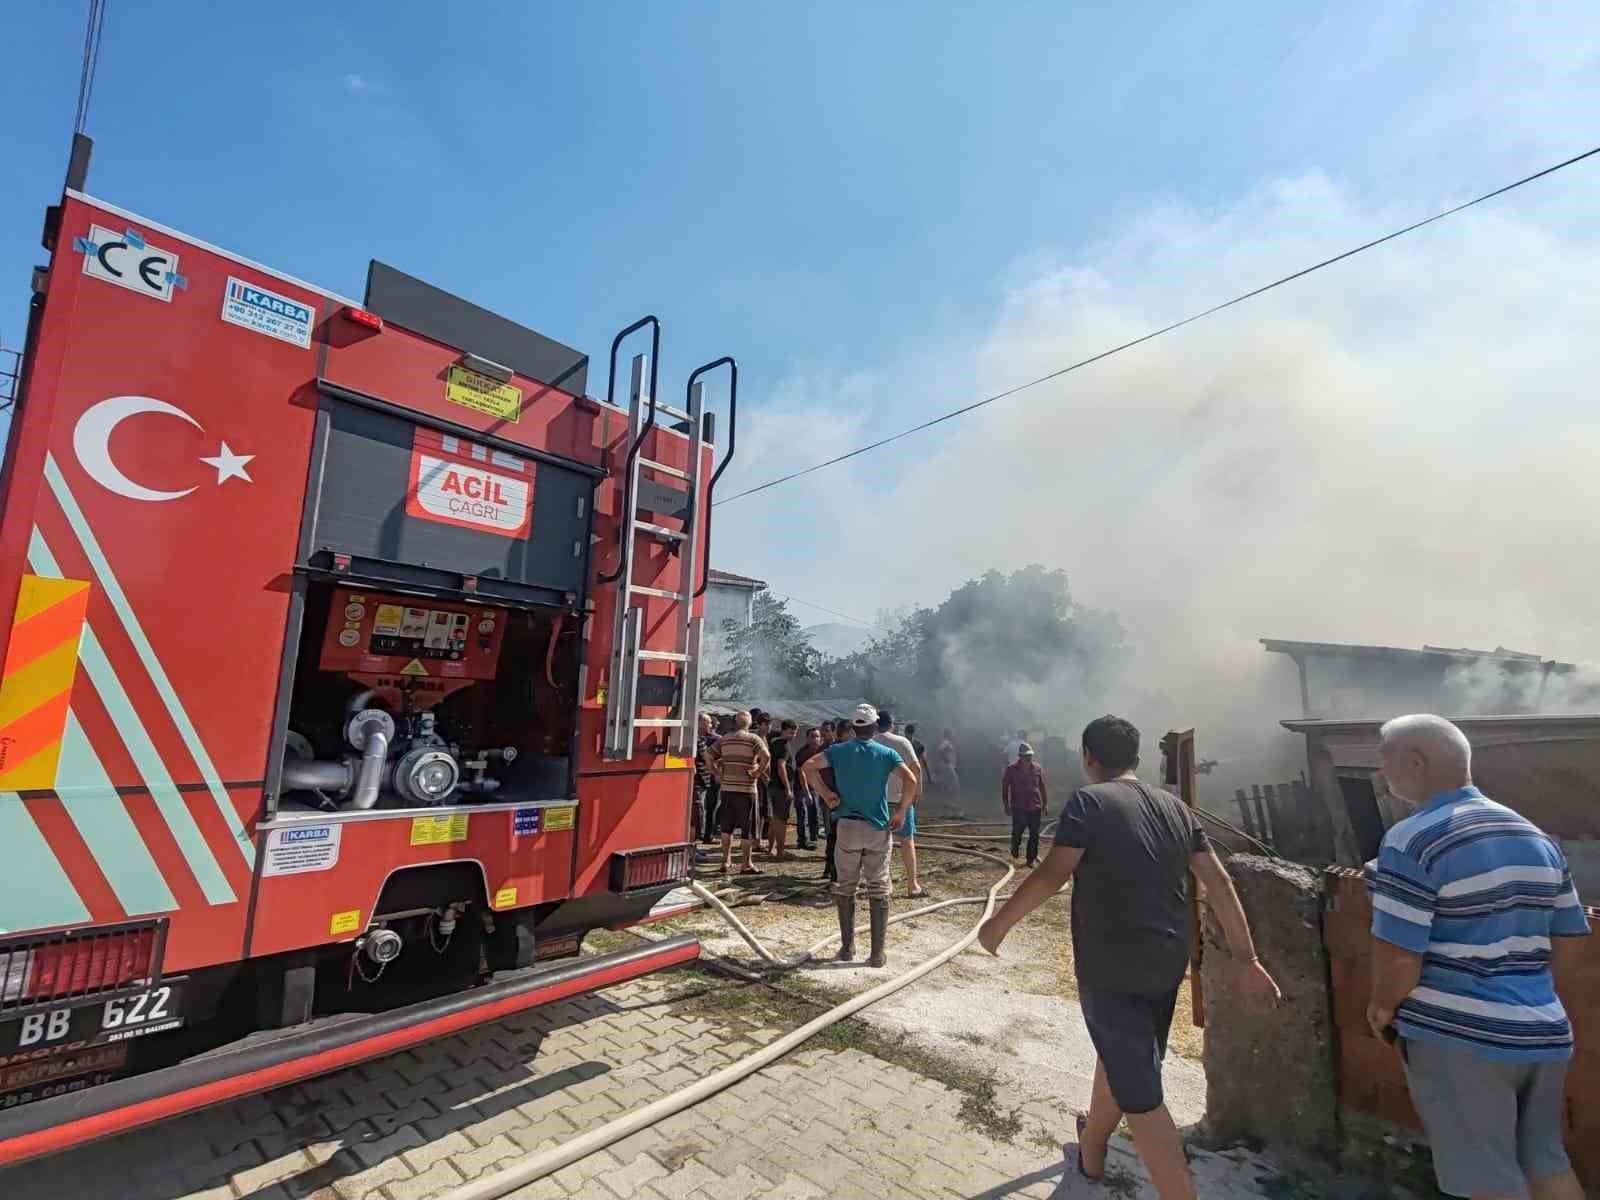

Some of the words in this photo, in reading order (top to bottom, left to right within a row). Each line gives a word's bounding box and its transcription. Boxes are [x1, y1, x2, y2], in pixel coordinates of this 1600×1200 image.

[246, 289, 308, 321] KARBA
[19, 1008, 71, 1046] BB
[102, 986, 171, 1028] 622
